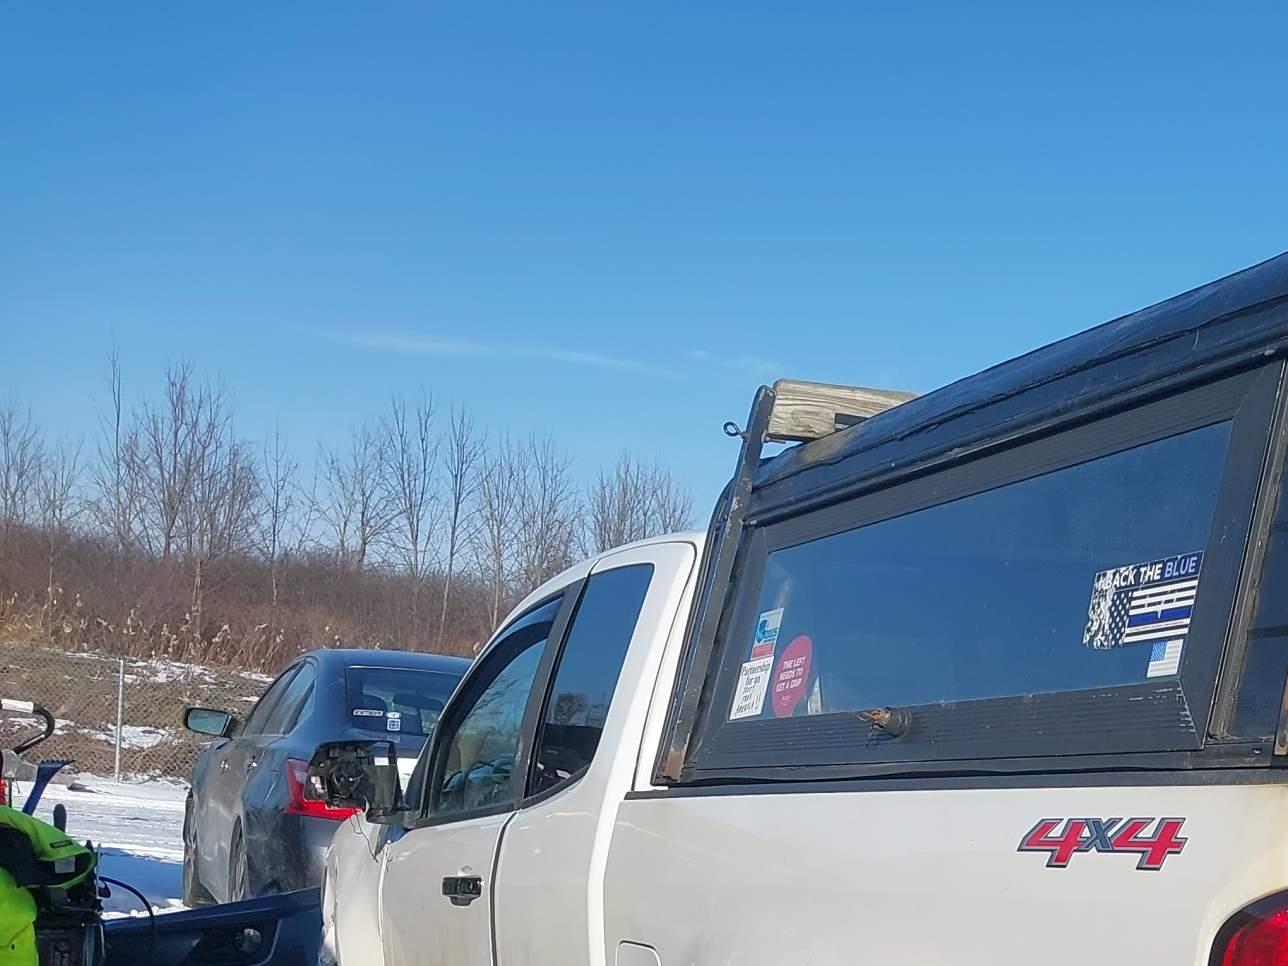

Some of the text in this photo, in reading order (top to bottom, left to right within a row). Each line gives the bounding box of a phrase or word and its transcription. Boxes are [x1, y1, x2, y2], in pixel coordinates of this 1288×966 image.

[1105, 568, 1137, 590] BACK
[1139, 563, 1163, 584] THE
[1164, 556, 1198, 578] BLUE
[783, 656, 807, 671] THE LEFT
[780, 670, 796, 682] NEEDS
